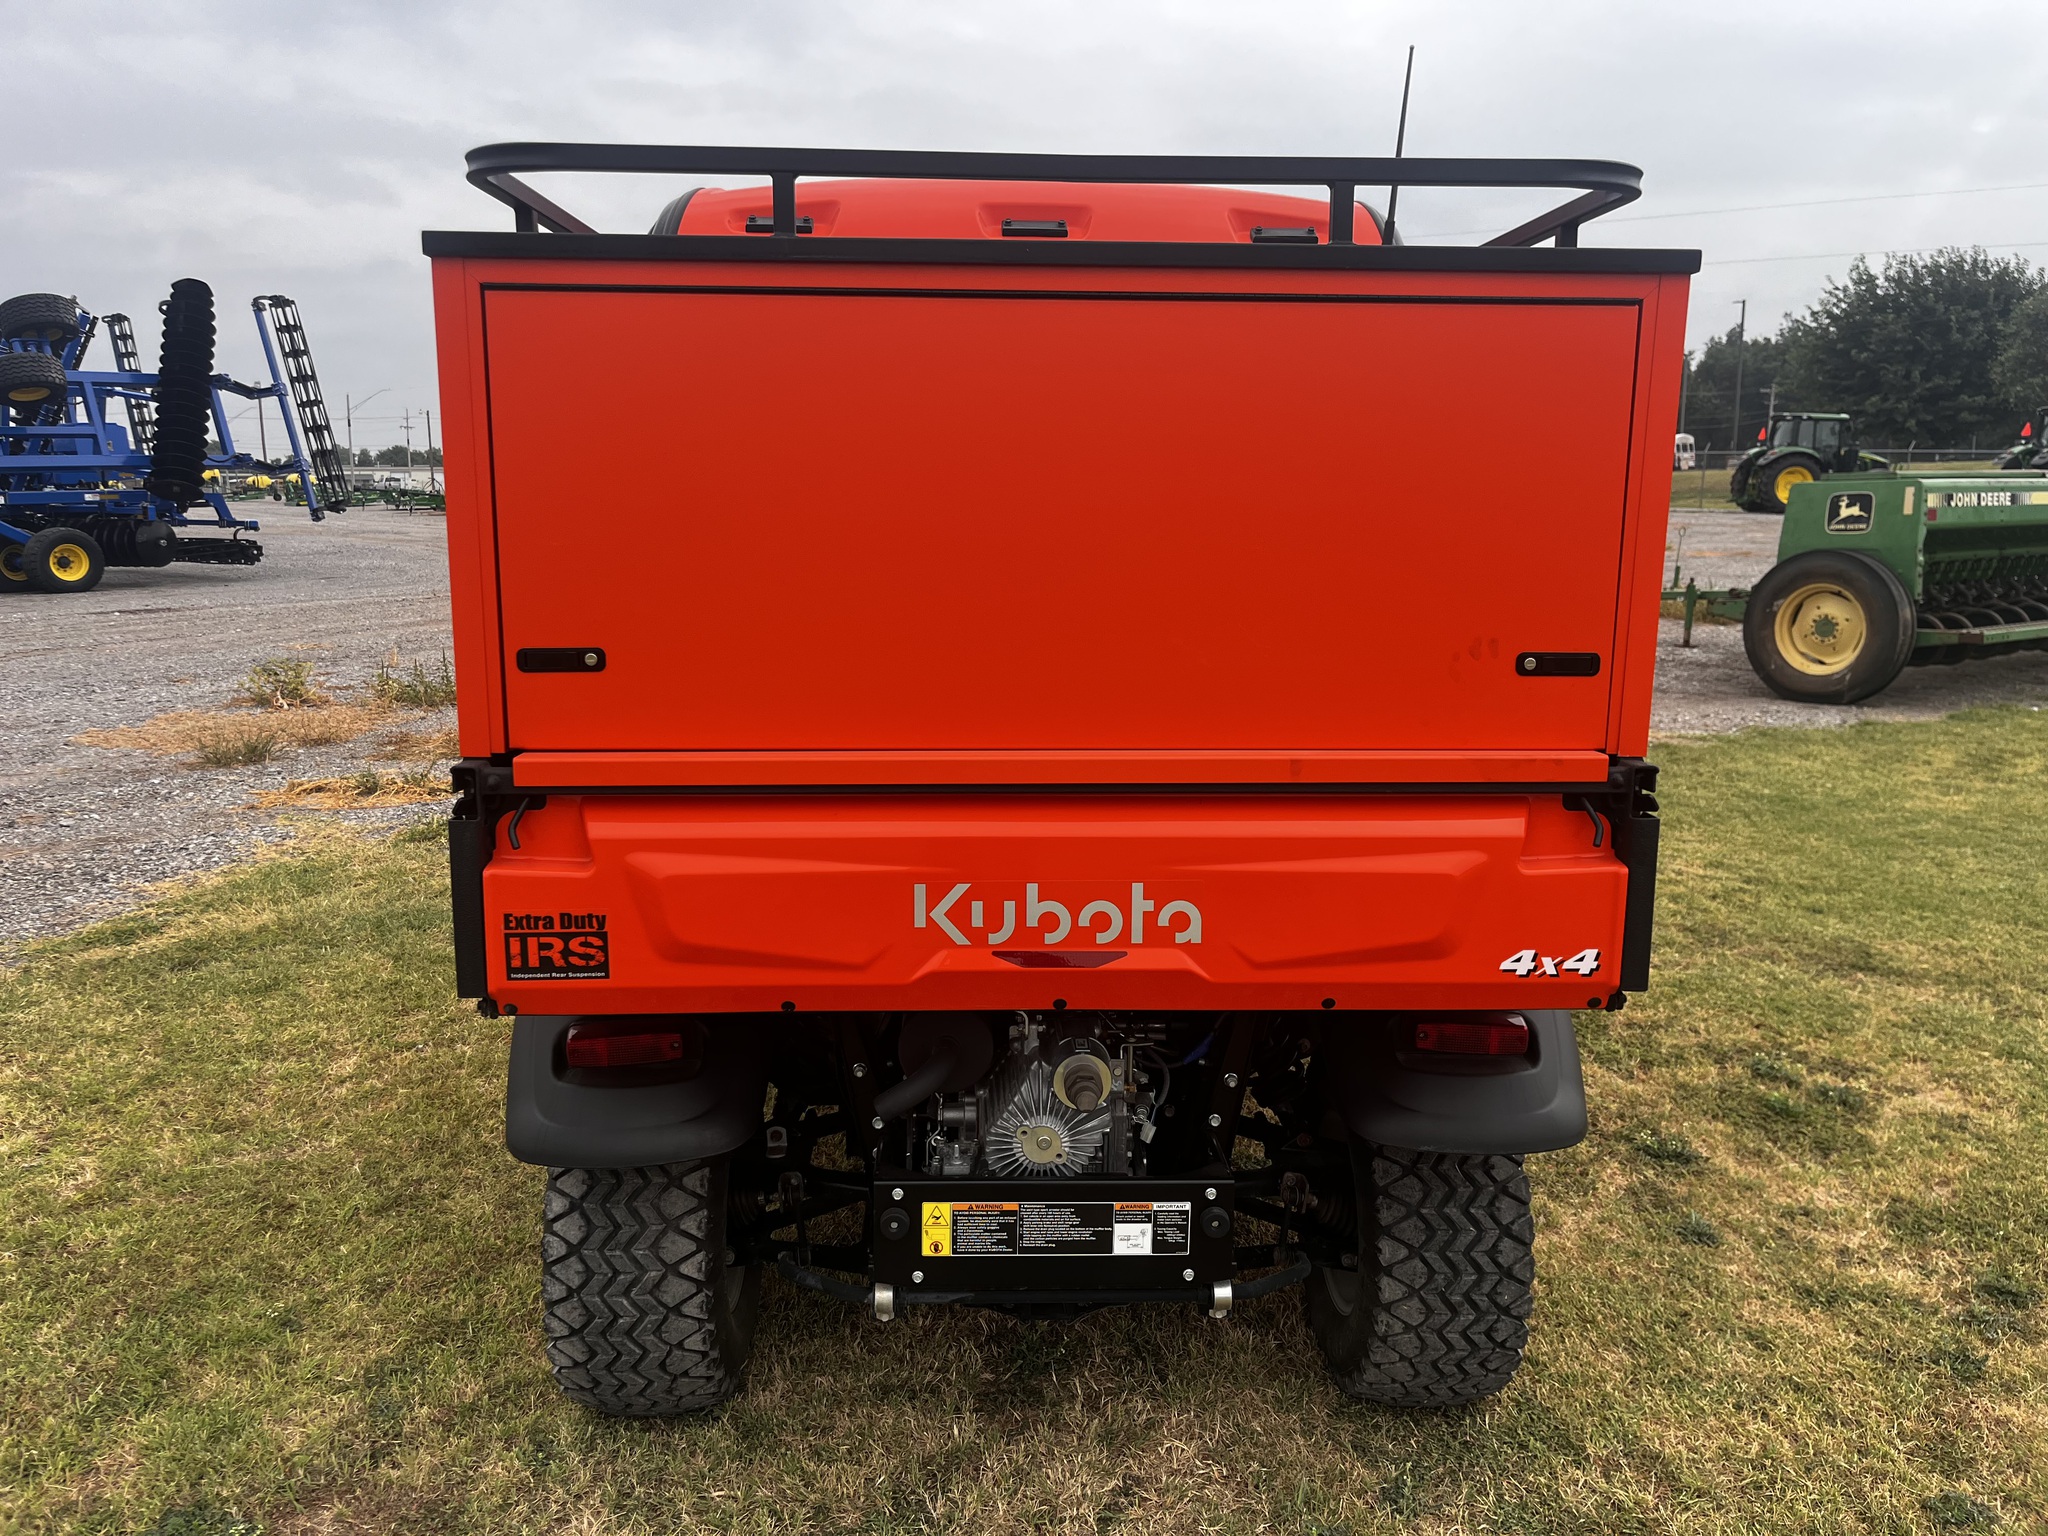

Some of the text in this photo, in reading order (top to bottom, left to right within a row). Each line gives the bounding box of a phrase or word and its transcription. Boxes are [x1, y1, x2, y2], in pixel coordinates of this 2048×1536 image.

[1950, 491, 2011, 507] JOHN DEERE
[504, 913, 607, 931] Extra Duty
[914, 882, 1203, 946] Kubota
[509, 936, 606, 968] IRS
[1499, 948, 1602, 978] 4x4
